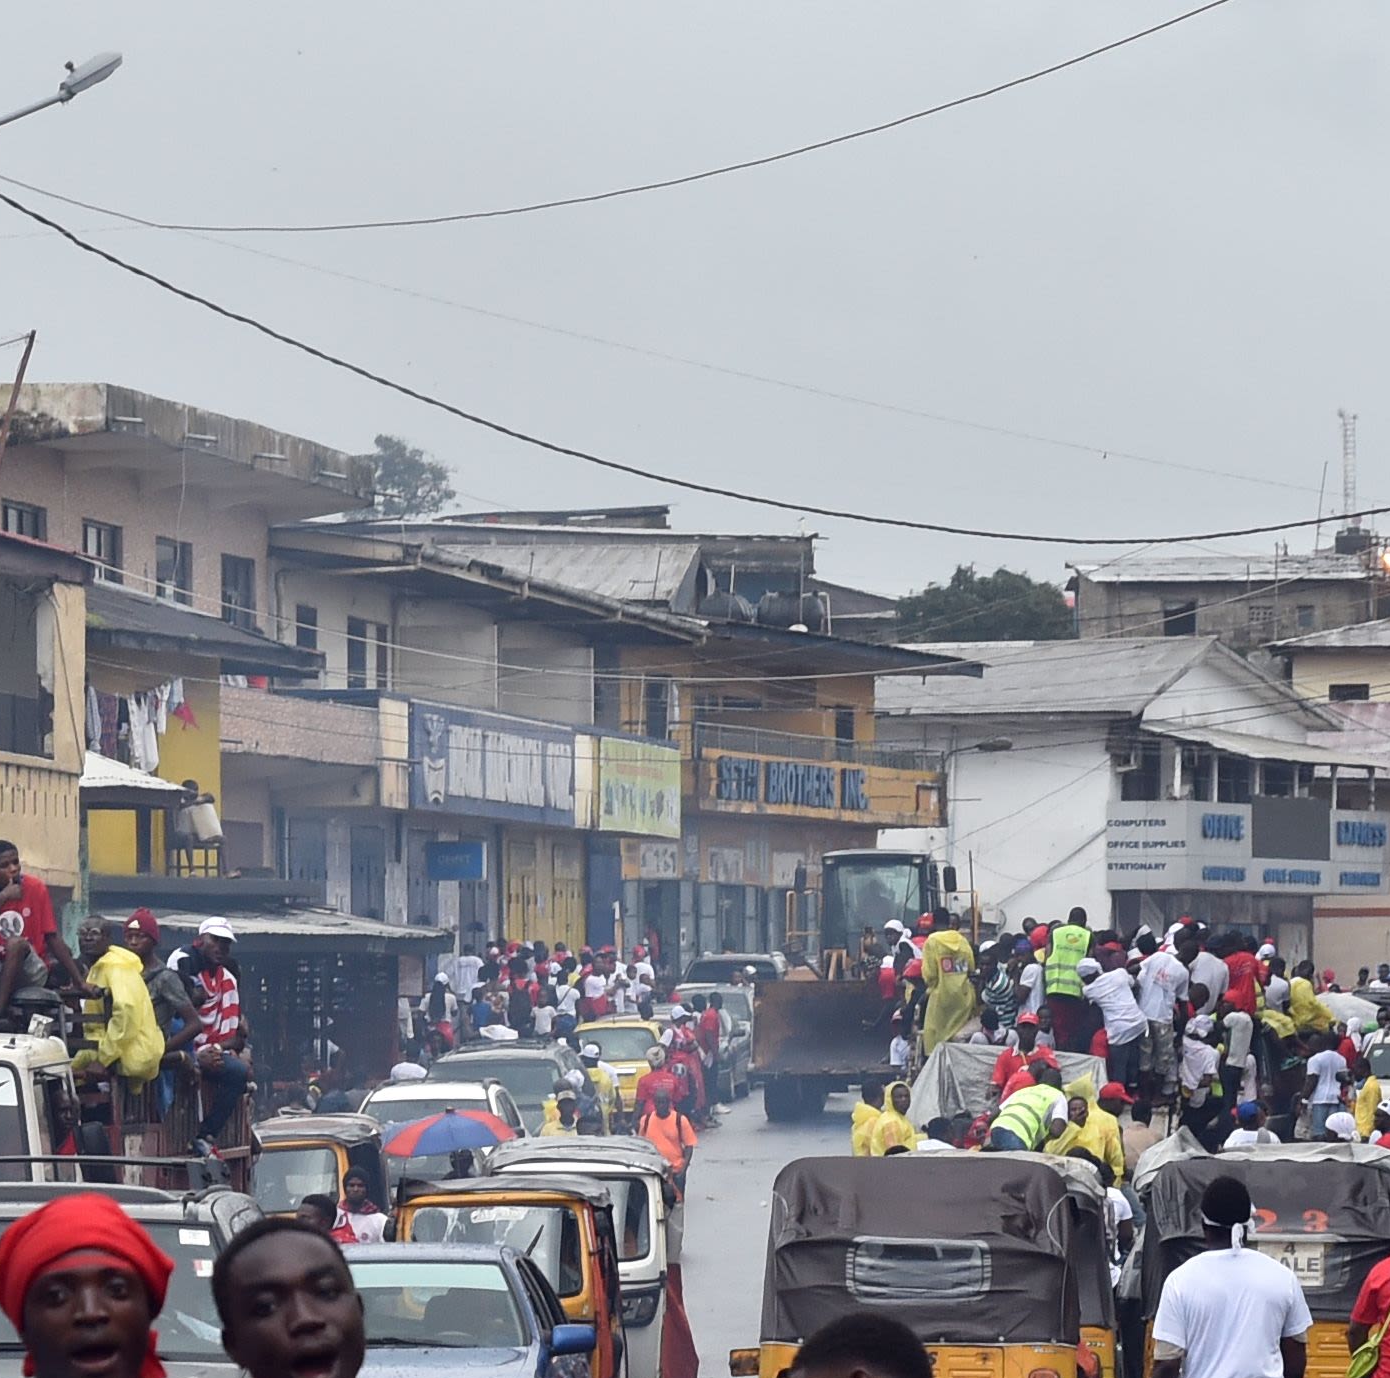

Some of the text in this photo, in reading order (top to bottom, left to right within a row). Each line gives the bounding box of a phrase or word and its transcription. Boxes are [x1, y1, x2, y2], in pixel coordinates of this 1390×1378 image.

[718, 756, 758, 801] SETH
[765, 760, 836, 808] BROTHERS
[1107, 818, 1167, 828] COMPUTERS
[1107, 840, 1186, 849] OFFICE SUPPLIES
[1107, 862, 1167, 871] STATIONARY
[1302, 1208, 1329, 1233] 3
[1280, 1257, 1320, 1272] ALE
